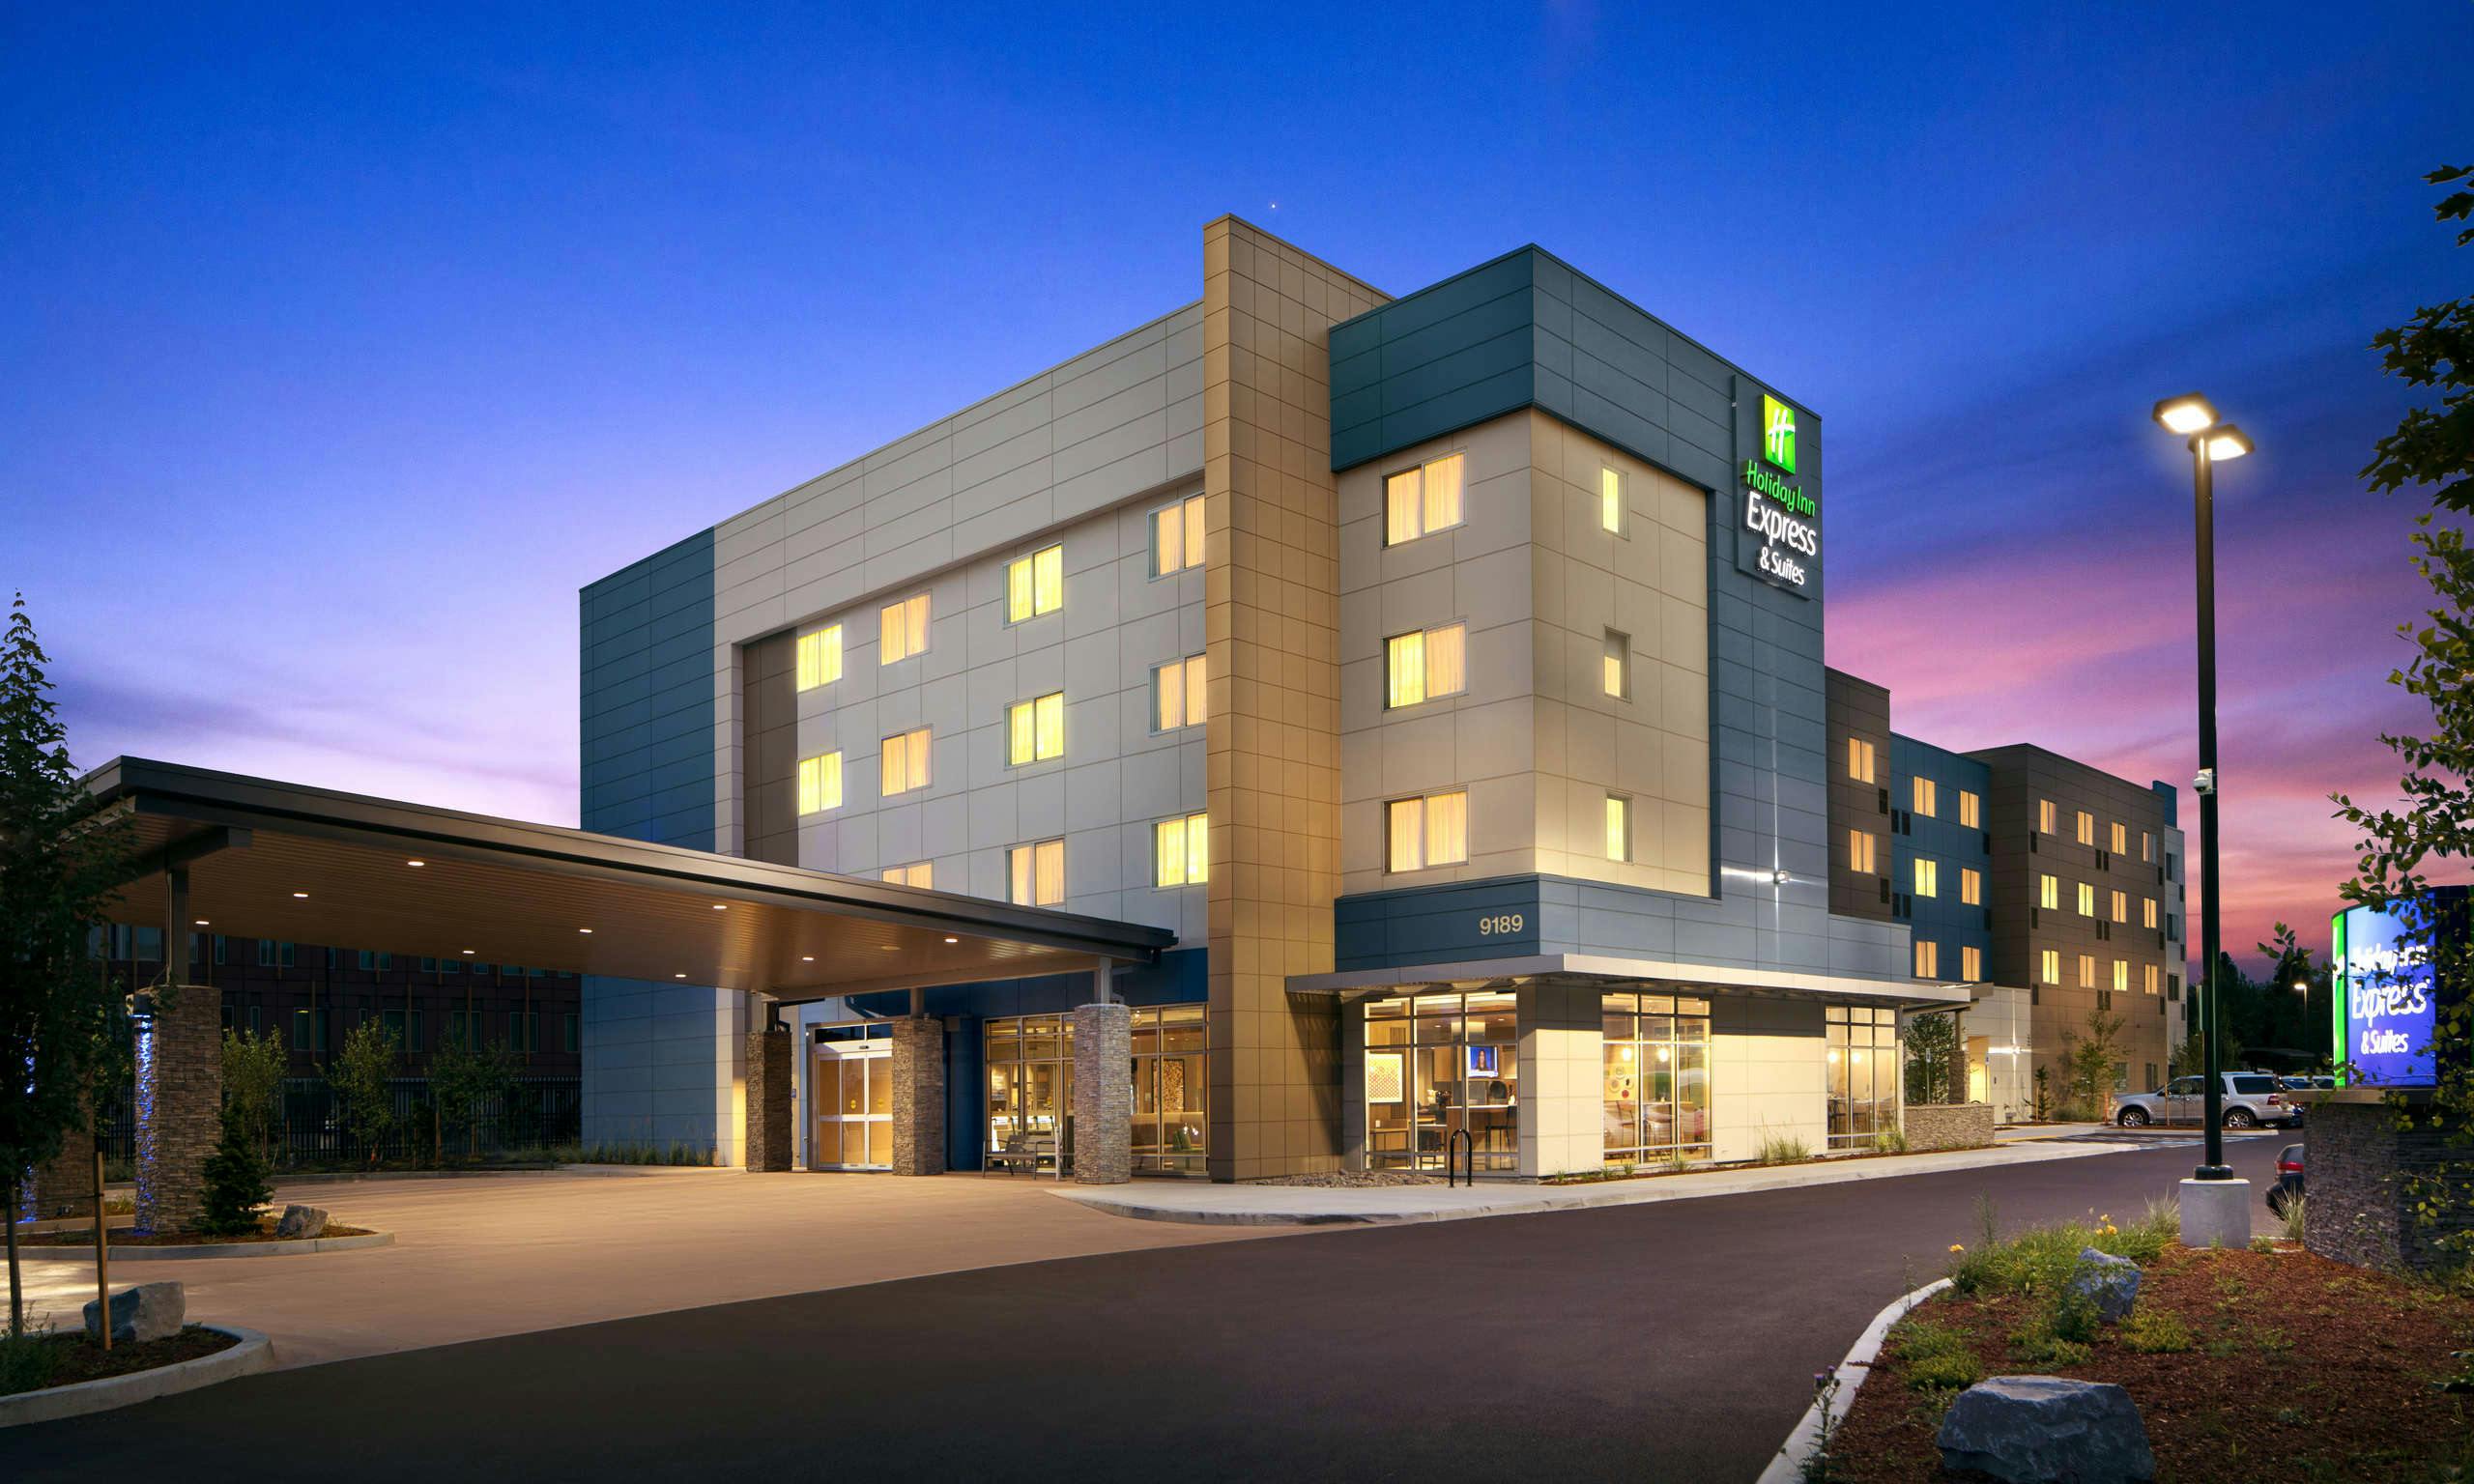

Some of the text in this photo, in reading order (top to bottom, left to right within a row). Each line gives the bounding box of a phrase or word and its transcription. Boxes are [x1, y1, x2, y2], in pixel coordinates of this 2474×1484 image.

[1746, 459, 1816, 518] Holiday Inn
[1747, 491, 1817, 556] Express
[1760, 546, 1805, 585] & Suites
[1480, 914, 1523, 935] 9189
[2361, 1029, 2408, 1055] & Suites
